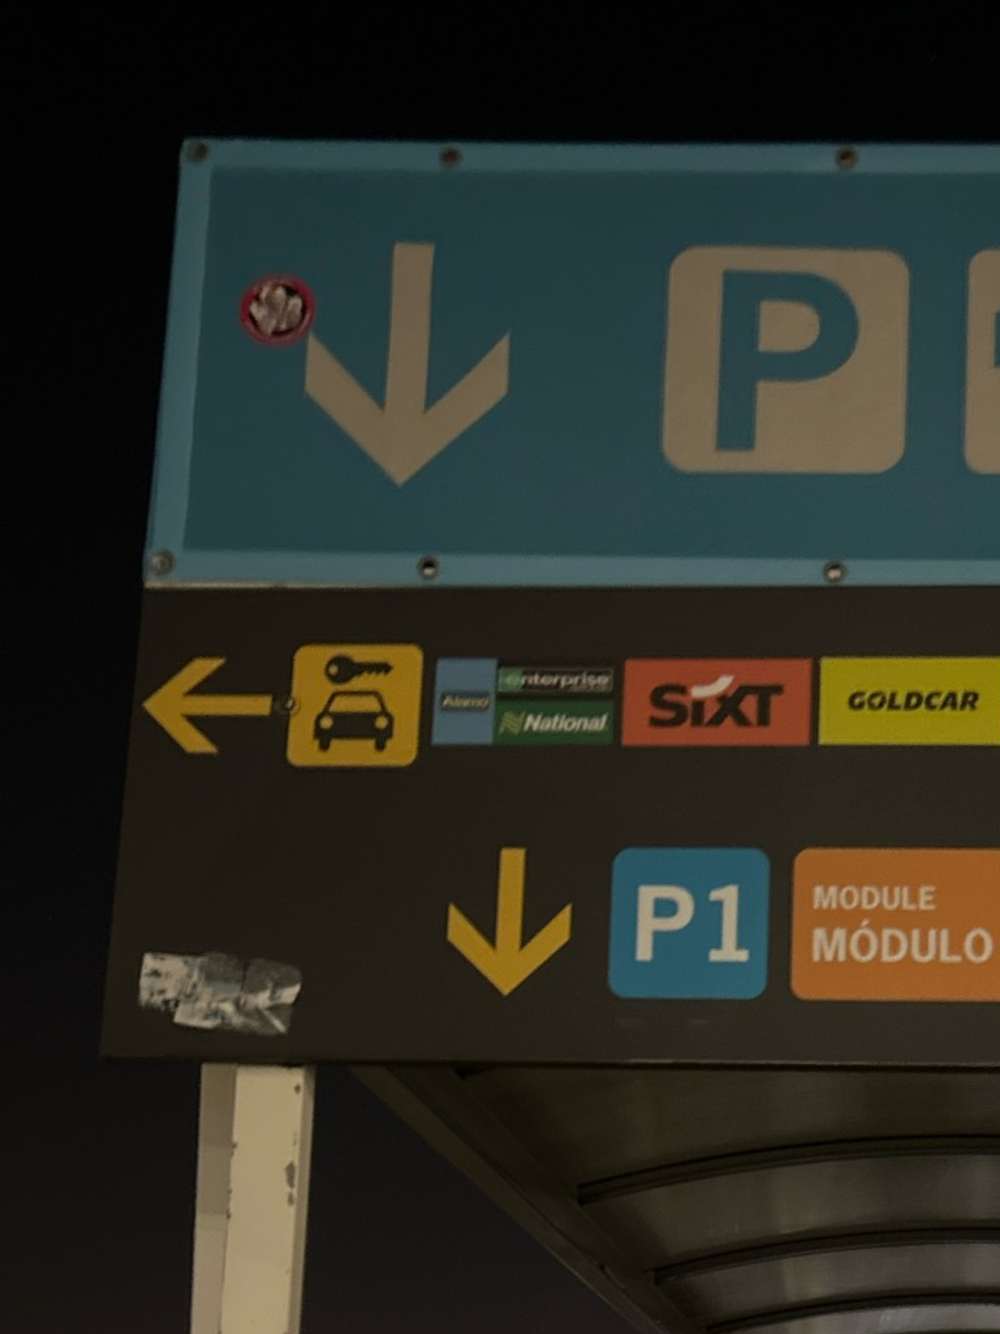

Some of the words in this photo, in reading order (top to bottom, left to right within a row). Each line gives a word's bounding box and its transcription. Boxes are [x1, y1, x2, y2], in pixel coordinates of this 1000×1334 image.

[715, 268, 861, 452] P
[503, 669, 611, 691] enterprise
[847, 690, 980, 712] GOLDCAR
[523, 711, 608, 733] National
[813, 885, 936, 911] MODULE
[635, 884, 750, 963] P1
[812, 919, 994, 964] MÓDULO
